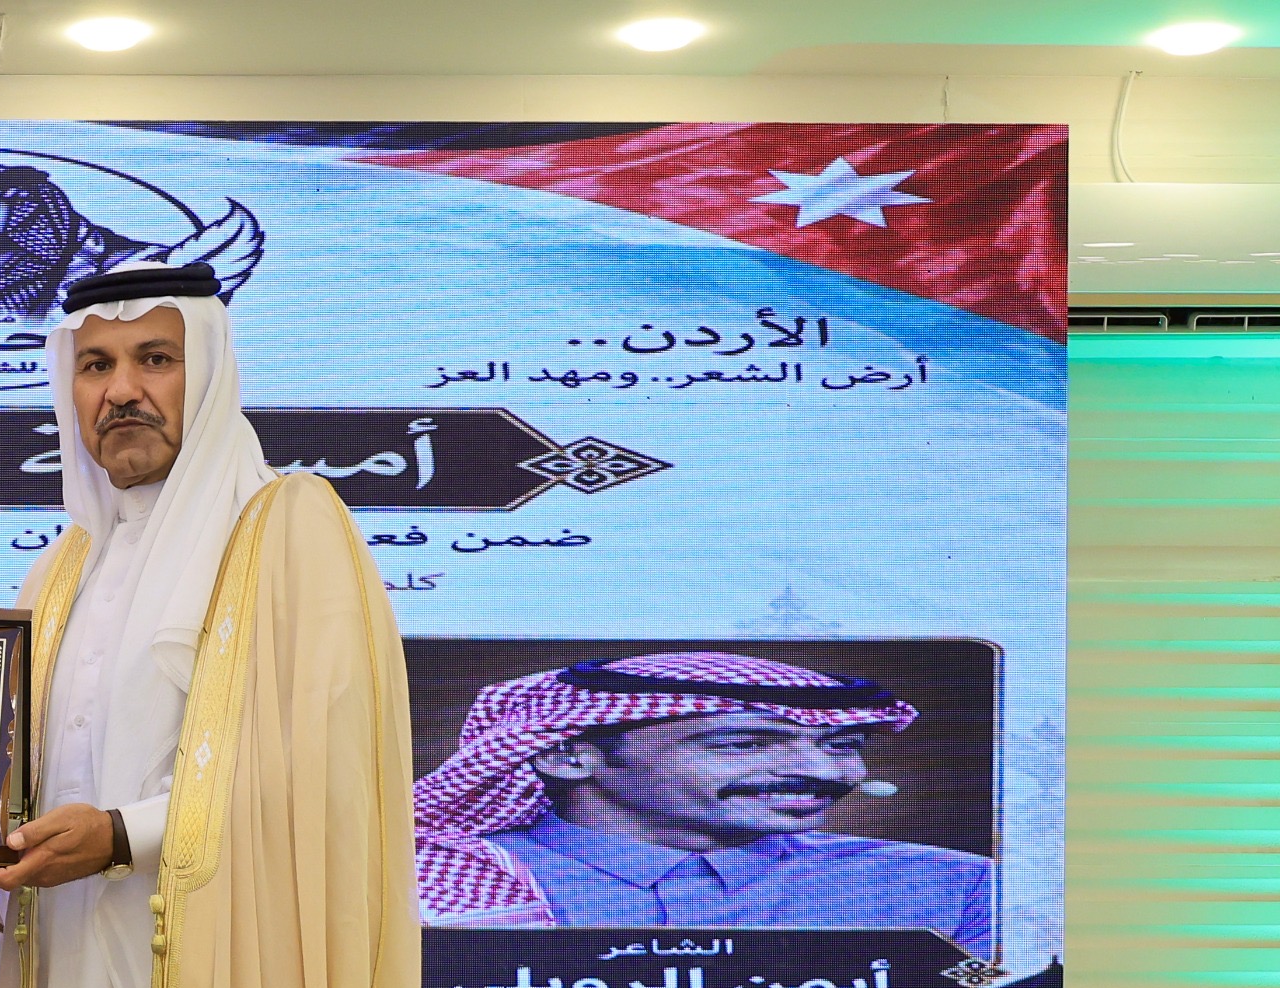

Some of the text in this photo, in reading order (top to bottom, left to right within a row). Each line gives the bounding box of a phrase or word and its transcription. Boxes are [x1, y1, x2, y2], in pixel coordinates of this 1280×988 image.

[422, 361, 510, 389] العز
[527, 364, 639, 390] ومهد
[820, 356, 928, 391] أرض
[450, 525, 592, 553] ضمن
[597, 938, 734, 961] الشاعر
